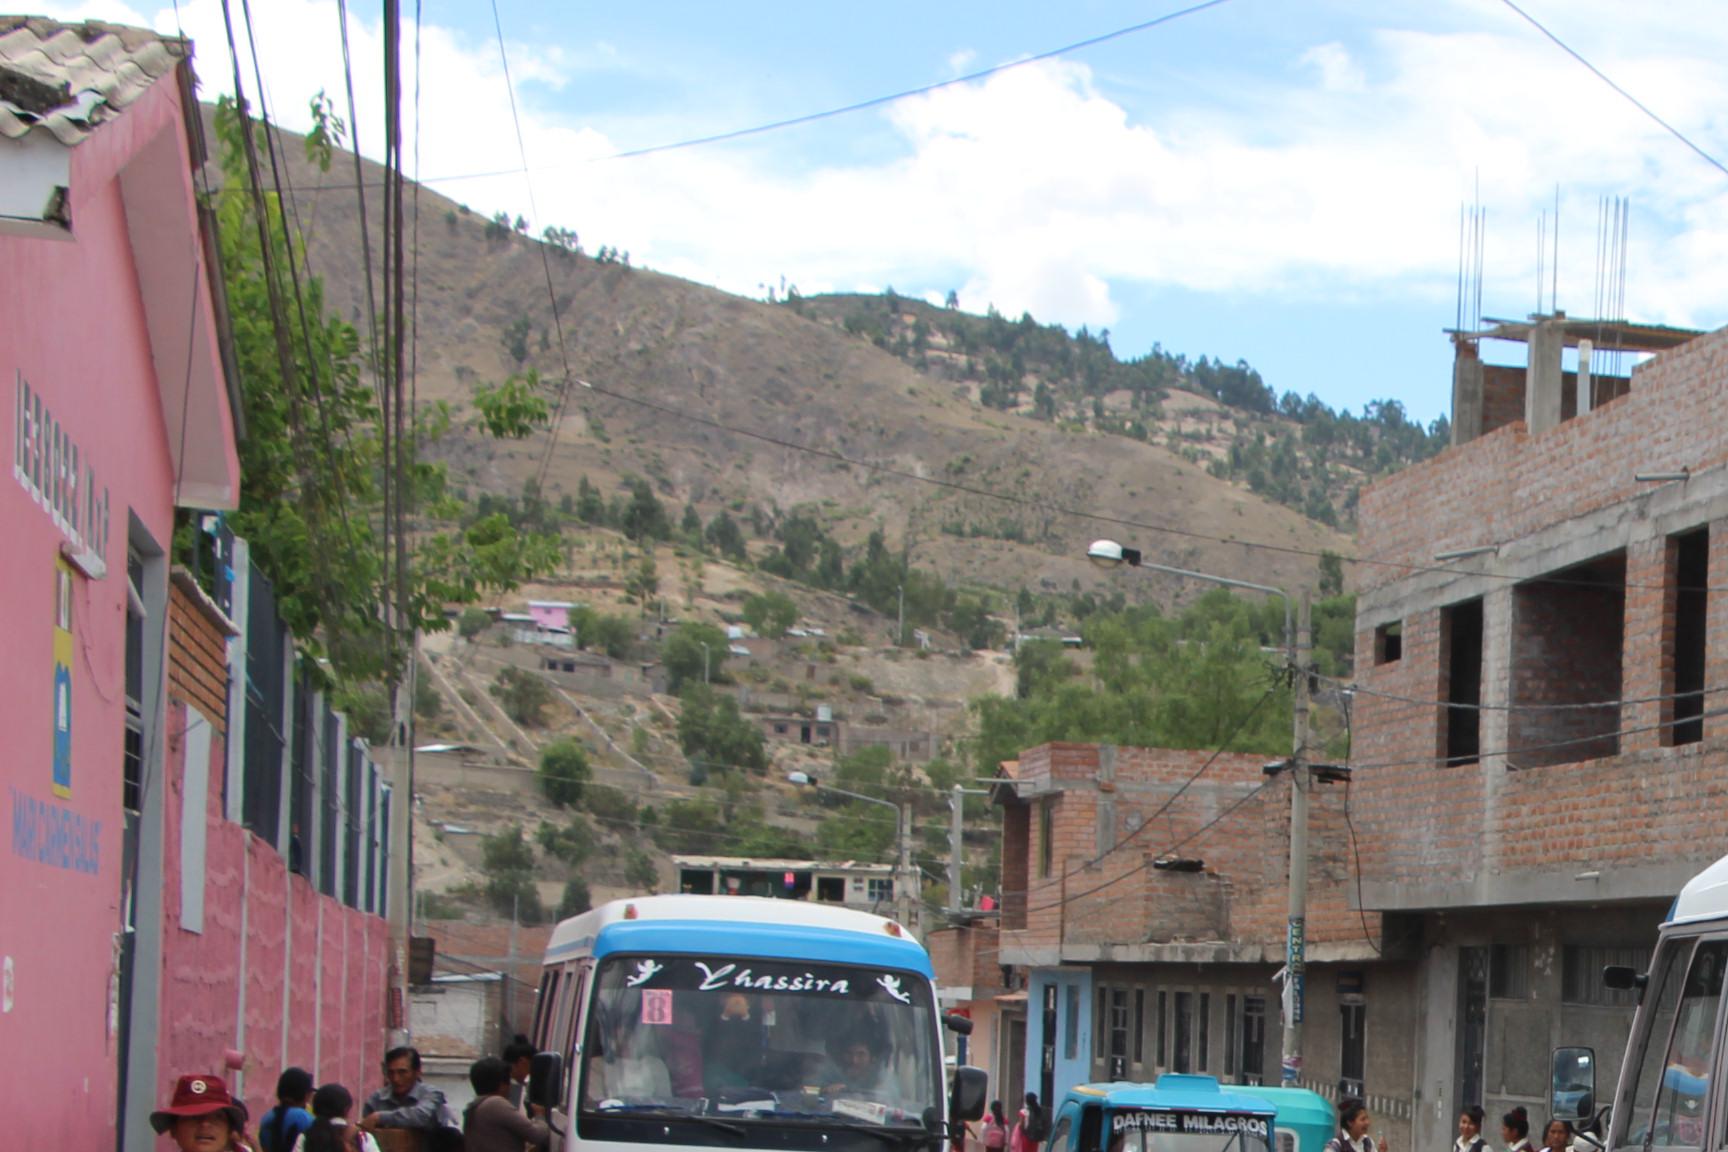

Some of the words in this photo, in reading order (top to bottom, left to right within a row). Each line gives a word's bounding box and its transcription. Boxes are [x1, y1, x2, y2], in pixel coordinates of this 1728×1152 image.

[694, 961, 849, 994] Yhassira
[1113, 1113, 1177, 1130] DAFNEE
[1183, 1114, 1268, 1136] MILAGROS
